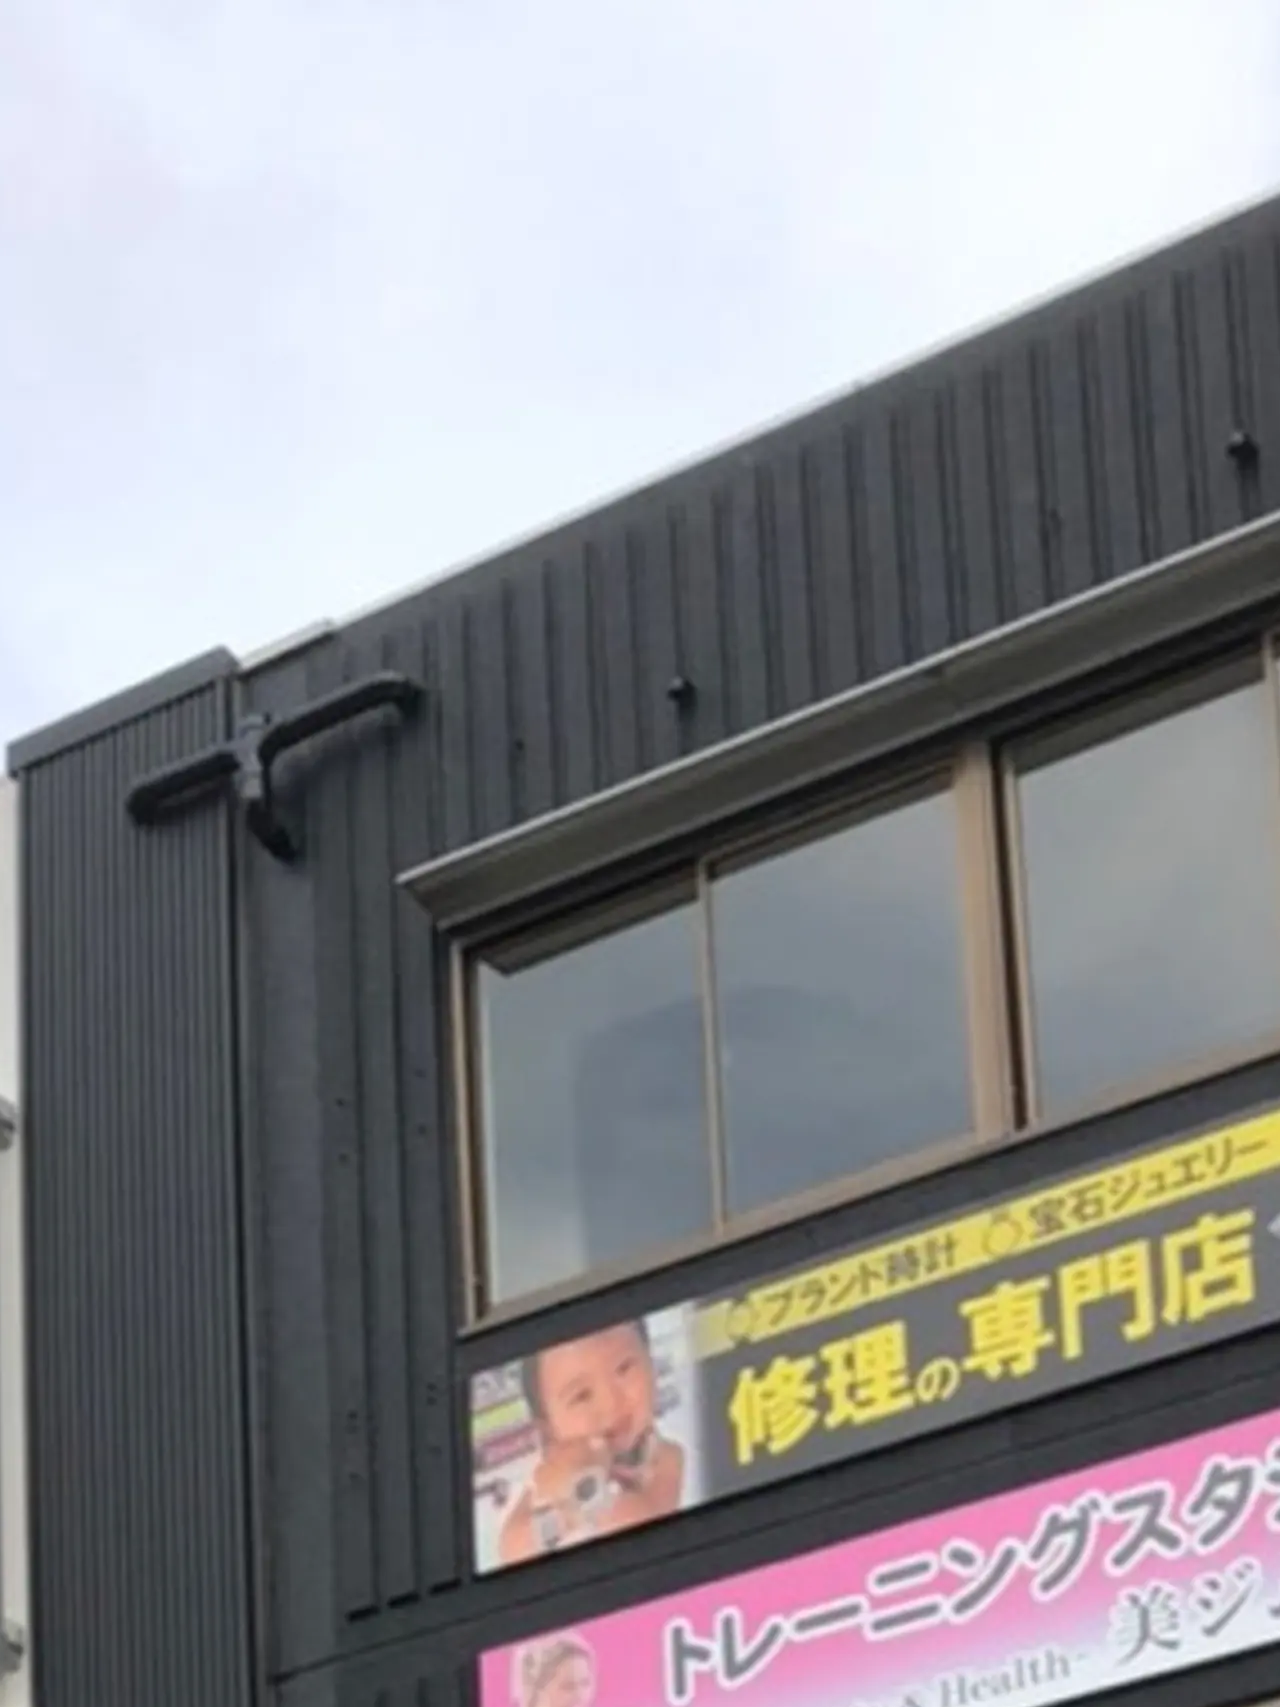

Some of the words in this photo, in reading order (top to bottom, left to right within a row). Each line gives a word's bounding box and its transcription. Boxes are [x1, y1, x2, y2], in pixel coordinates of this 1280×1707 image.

[729, 1209, 1255, 1466] 修理の専門店
[766, 1234, 959, 1326] ブランド時計
[1028, 1137, 1268, 1239] 宝石ジュエリー
